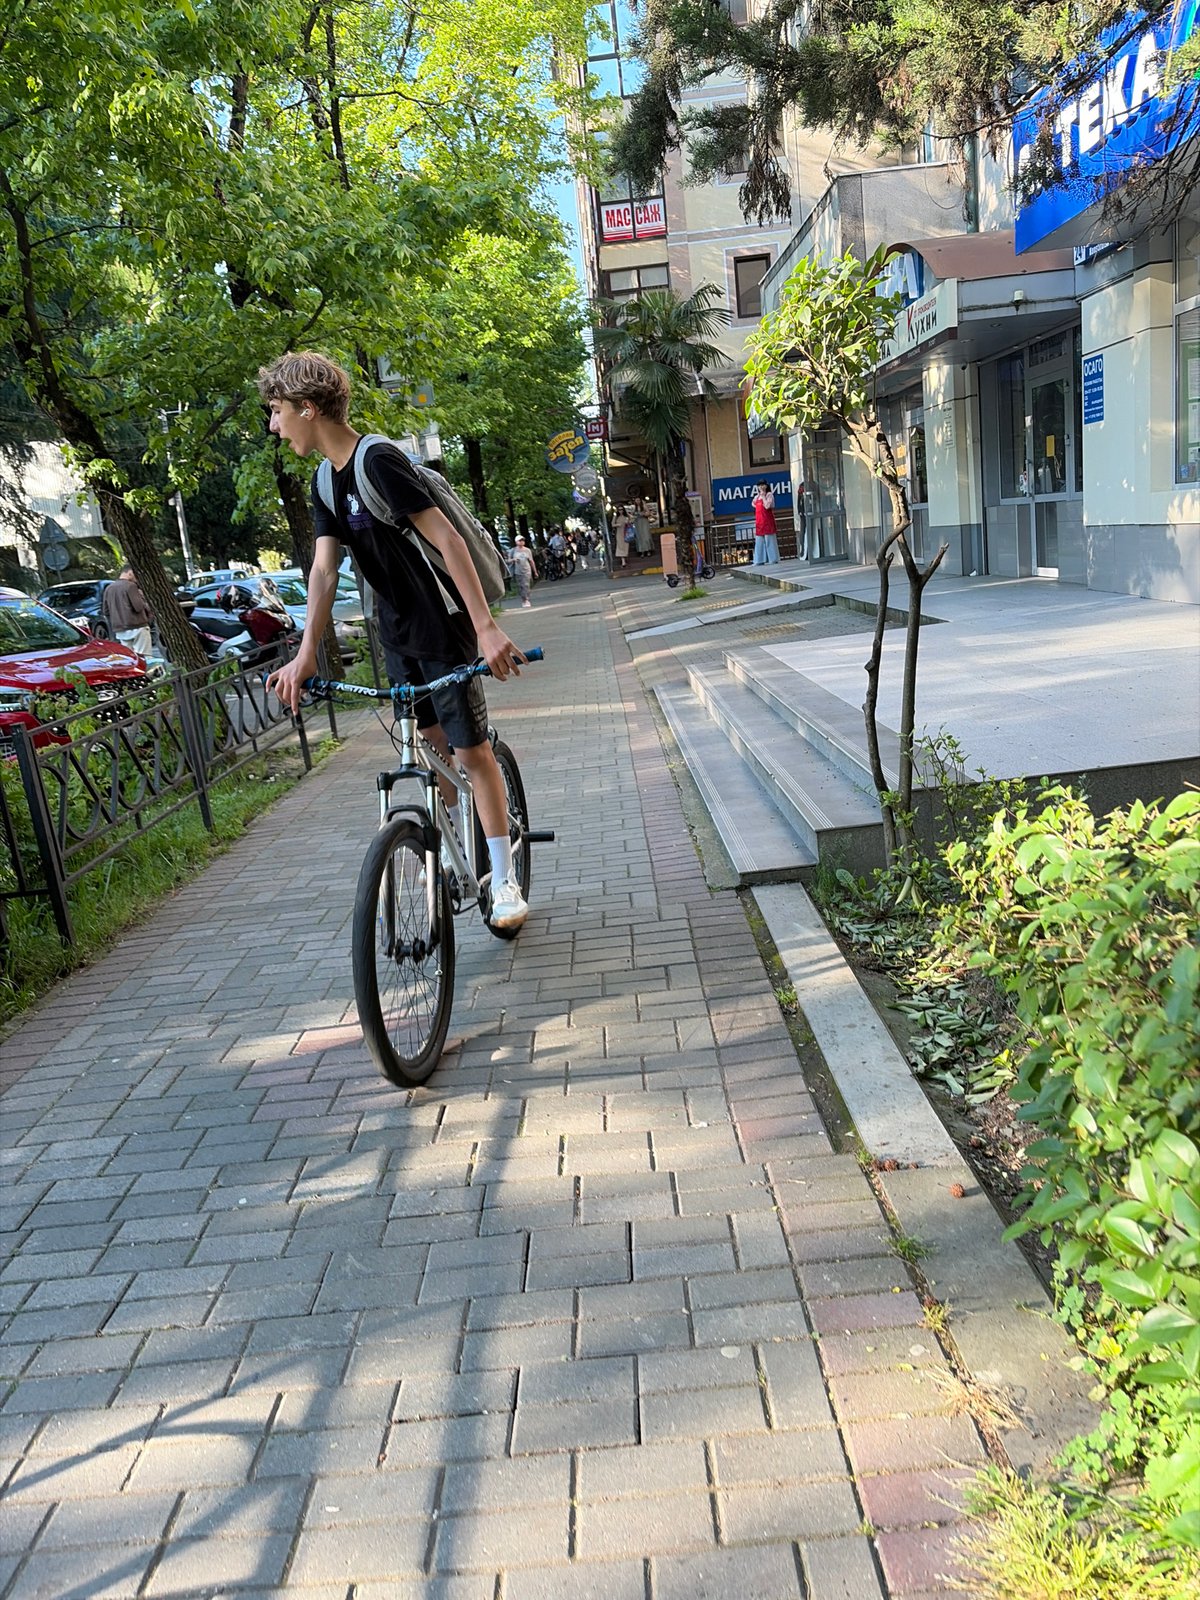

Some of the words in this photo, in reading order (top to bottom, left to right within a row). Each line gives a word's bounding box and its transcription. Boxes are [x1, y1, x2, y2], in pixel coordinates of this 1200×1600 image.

[1084, 359, 1103, 376] ОСАГО
[719, 481, 792, 501] МАГАИН
[336, 682, 378, 696] ASTRO
